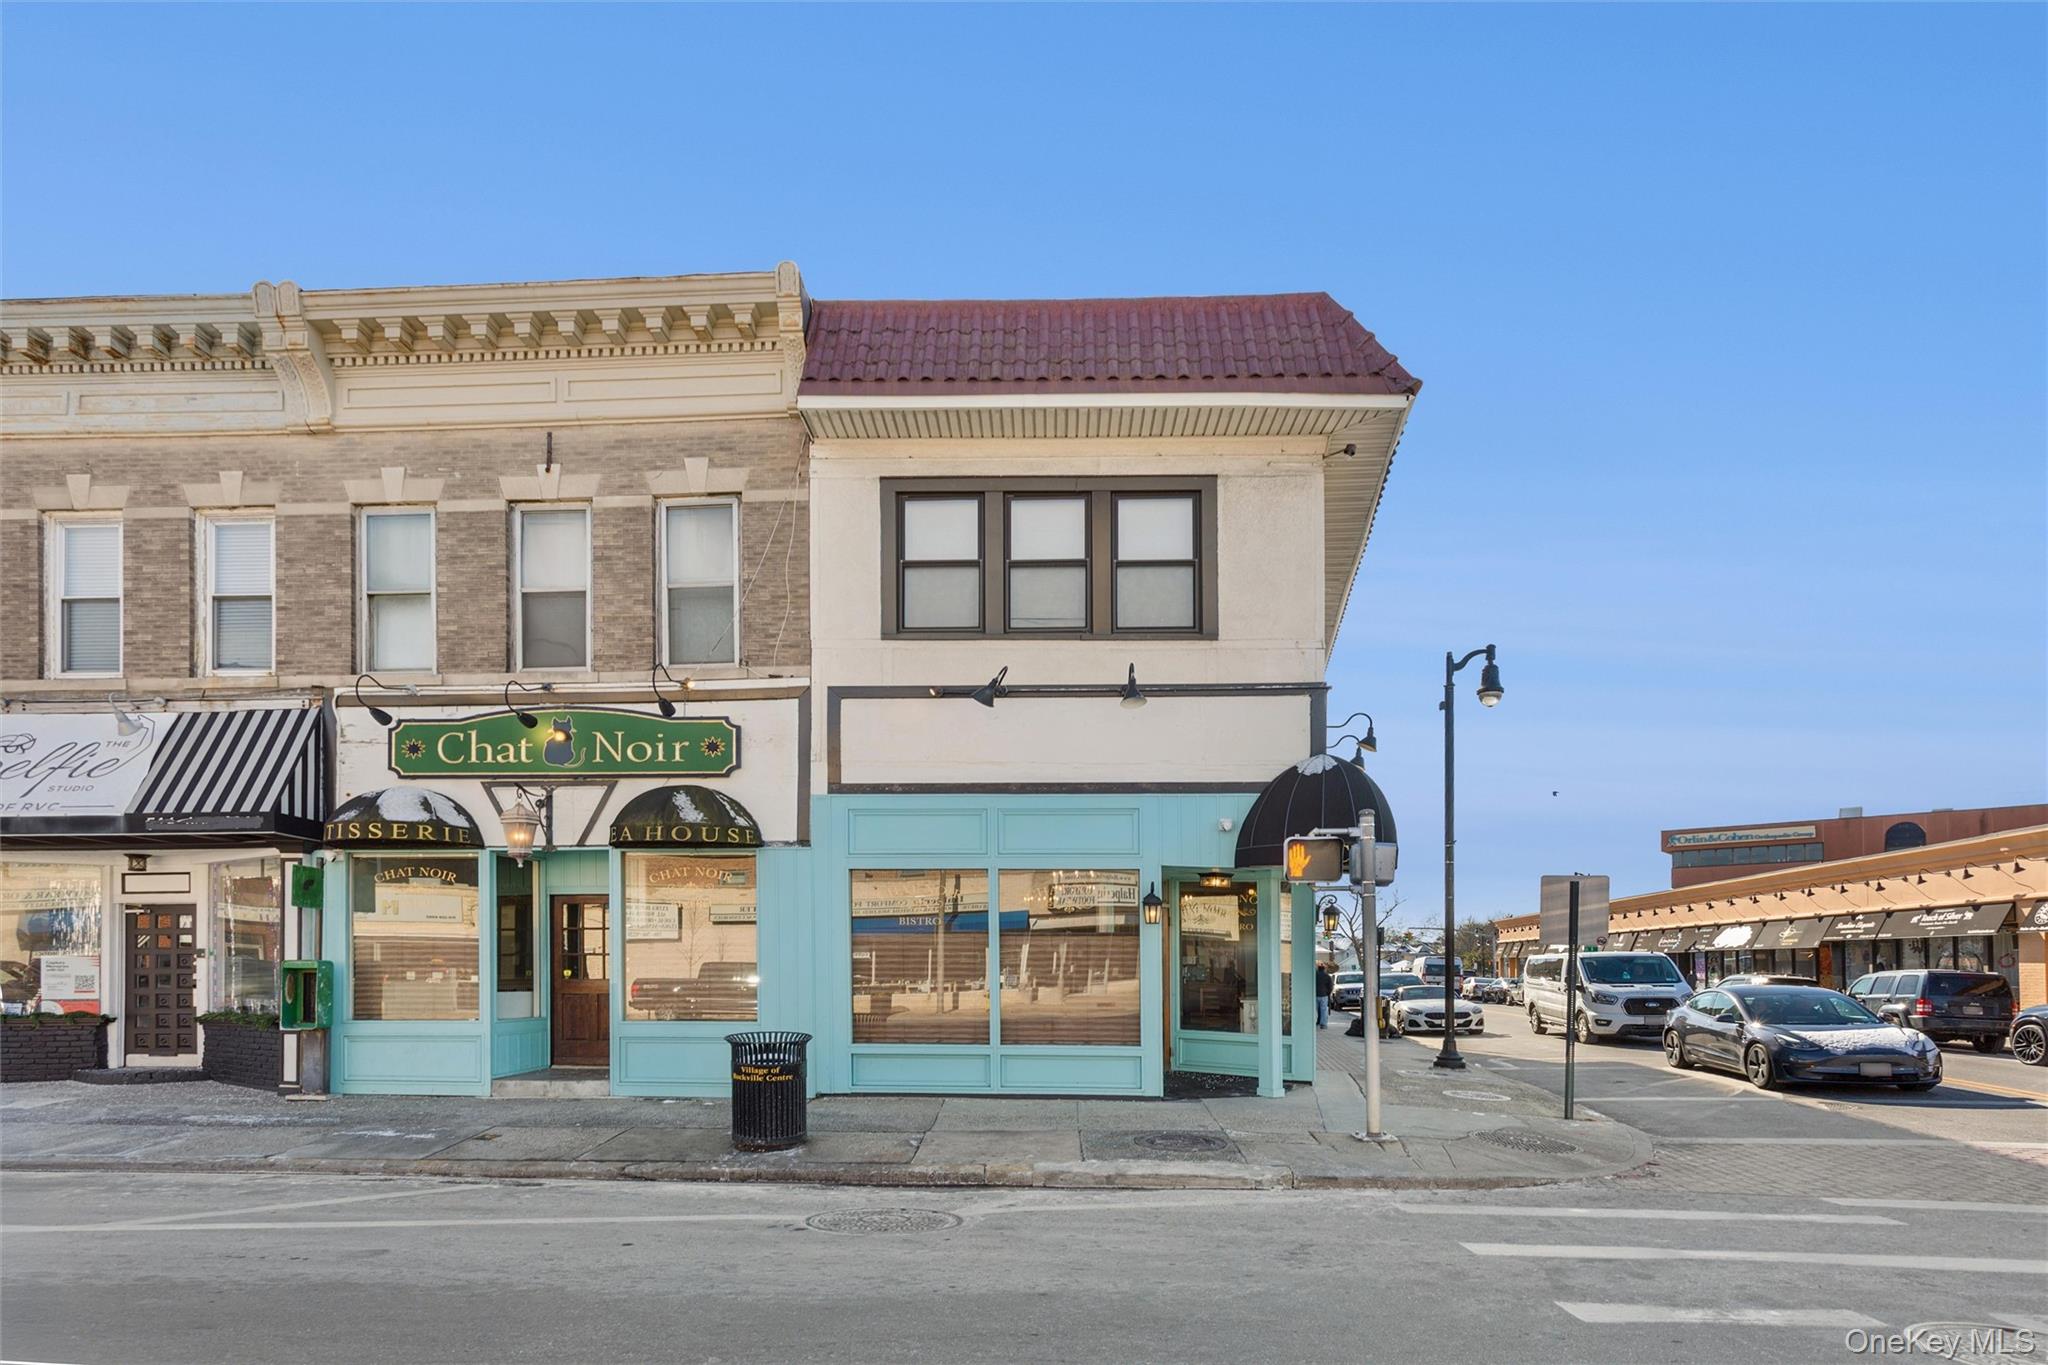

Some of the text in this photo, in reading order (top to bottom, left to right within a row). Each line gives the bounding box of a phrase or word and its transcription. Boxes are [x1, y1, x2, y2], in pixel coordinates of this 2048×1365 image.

[105, 740, 131, 748] THE
[436, 730, 690, 764] Chat Noir
[0, 741, 121, 799] elfie
[47, 784, 95, 793] STUDIO
[20, 802, 60, 812] RVC
[374, 866, 457, 883] CHAT NOIR
[649, 866, 733, 883] CHAT NOIR
[899, 917, 942, 926] BISTRO
[741, 1066, 781, 1075] Village of
[766, 1074, 794, 1082] Centre
